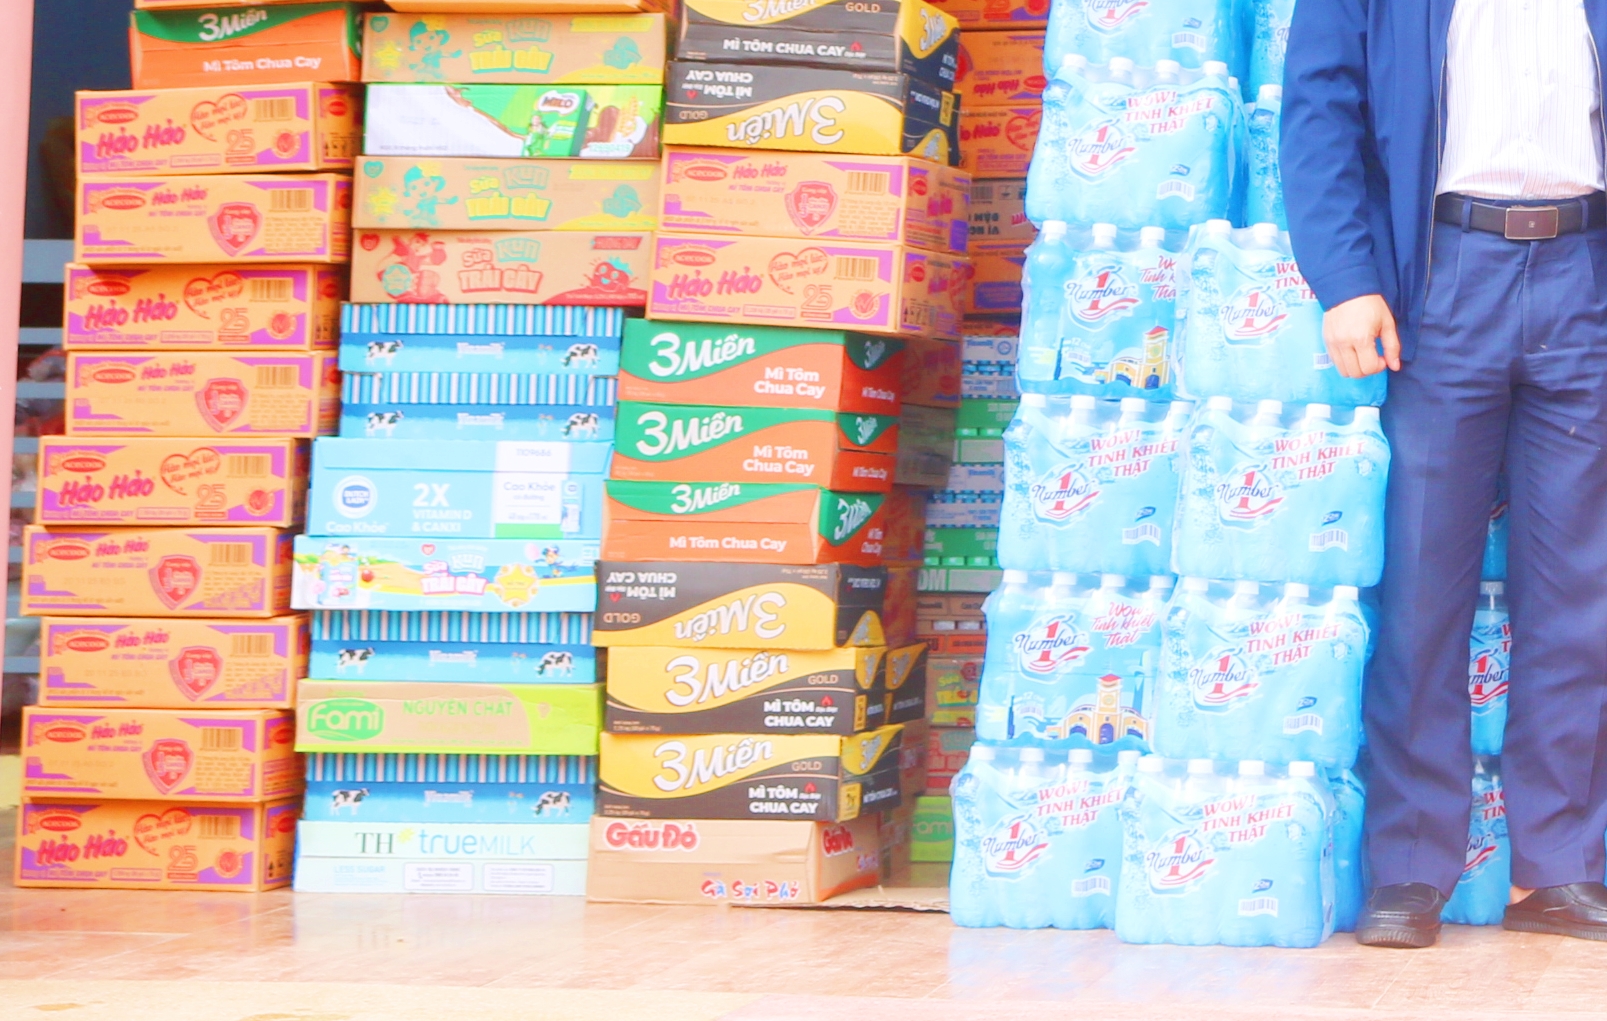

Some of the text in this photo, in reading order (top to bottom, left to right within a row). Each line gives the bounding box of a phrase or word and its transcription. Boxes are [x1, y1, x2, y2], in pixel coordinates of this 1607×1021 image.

[845, 2, 881, 13] GOLD
[723, 38, 845, 57] MÌ TÔM CHUA CAY
[202, 55, 322, 72] Mì Tôm Chua Cay
[685, 70, 753, 83] CHUA CAY
[703, 84, 753, 99] MÌ TÔM
[679, 110, 709, 120] GOLD
[97, 119, 185, 159] Hảo Hảo
[732, 161, 787, 180] Hảo Hảo
[667, 266, 762, 300] Hảo Hảo
[1065, 280, 1128, 301] Number
[83, 294, 178, 330] Hảo Hảo
[1220, 302, 1279, 322] Number
[140, 360, 196, 380] Hảo Hảo
[764, 366, 820, 382] Mì Tôm
[753, 381, 825, 399] Chua Cay
[1089, 429, 1142, 452] WOW!
[1088, 448, 1129, 468] TINH
[1112, 457, 1151, 478] THẬT
[58, 470, 155, 507] Hảo Hảo
[412, 482, 450, 508] 2X
[1031, 479, 1090, 503] Number
[669, 536, 787, 553] Mì Tôm Chua Cay
[1248, 612, 1302, 637] WOW!
[114, 628, 169, 648] Hảo Hảo
[1013, 629, 1079, 652] Number
[1245, 634, 1287, 654] TINH
[1271, 642, 1313, 667] THẬT
[807, 674, 839, 685] GOLD
[1189, 665, 1253, 686] Number
[402, 699, 468, 715] NGUYÊN
[763, 698, 816, 713] MÌ TÔM
[763, 715, 835, 728] CHUA CAY
[791, 761, 822, 772] GOLD
[748, 784, 799, 800] MÌ TÔM
[749, 801, 819, 815] CHUA CAY
[1202, 794, 1257, 817] WOW!
[1202, 812, 1242, 833] TINH
[1227, 822, 1269, 843] THẬT
[36, 830, 128, 866] Hảo Hảo
[355, 832, 397, 854] TH
[1146, 847, 1207, 870] Number
[700, 879, 726, 897] Gà
